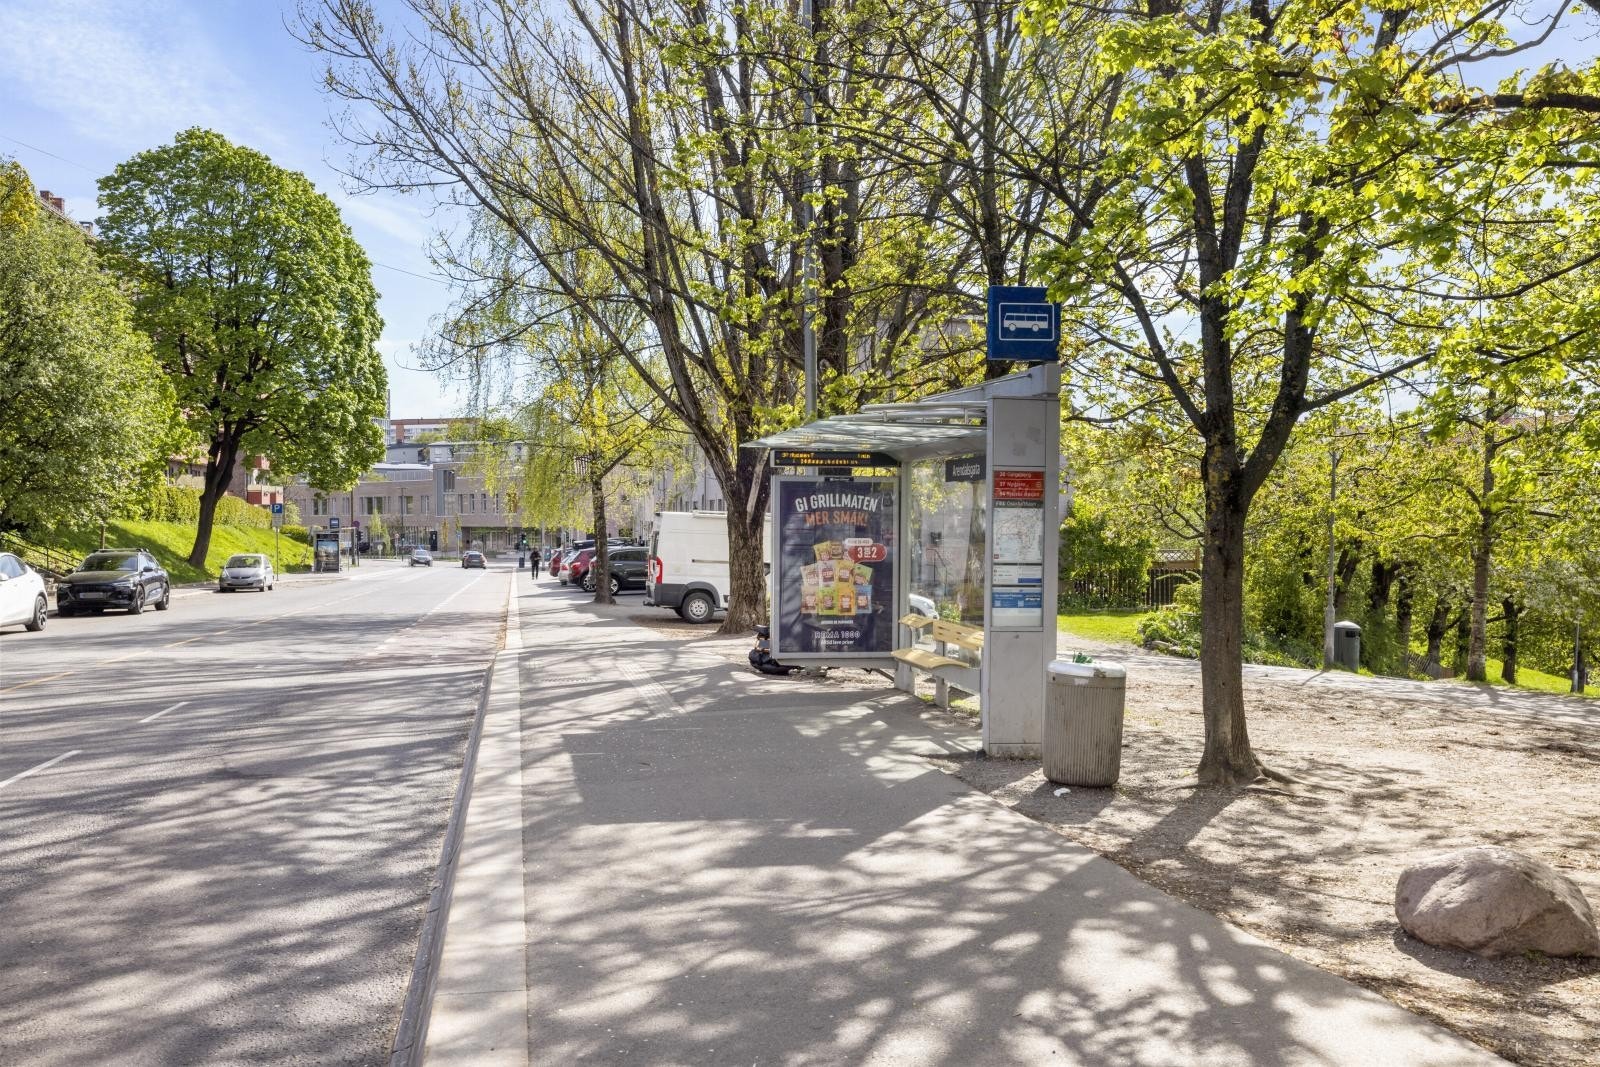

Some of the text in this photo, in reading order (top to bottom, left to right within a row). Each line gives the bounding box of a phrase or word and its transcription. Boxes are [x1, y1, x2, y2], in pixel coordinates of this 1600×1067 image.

[953, 463, 980, 479] Arendalsgata
[274, 504, 280, 513] P
[795, 493, 878, 513] GI GRILLMATEN
[805, 511, 869, 527] MER SMAK!
[857, 547, 863, 558] 3
[871, 547, 877, 558] 2
[814, 630, 861, 639] REMA 1000
